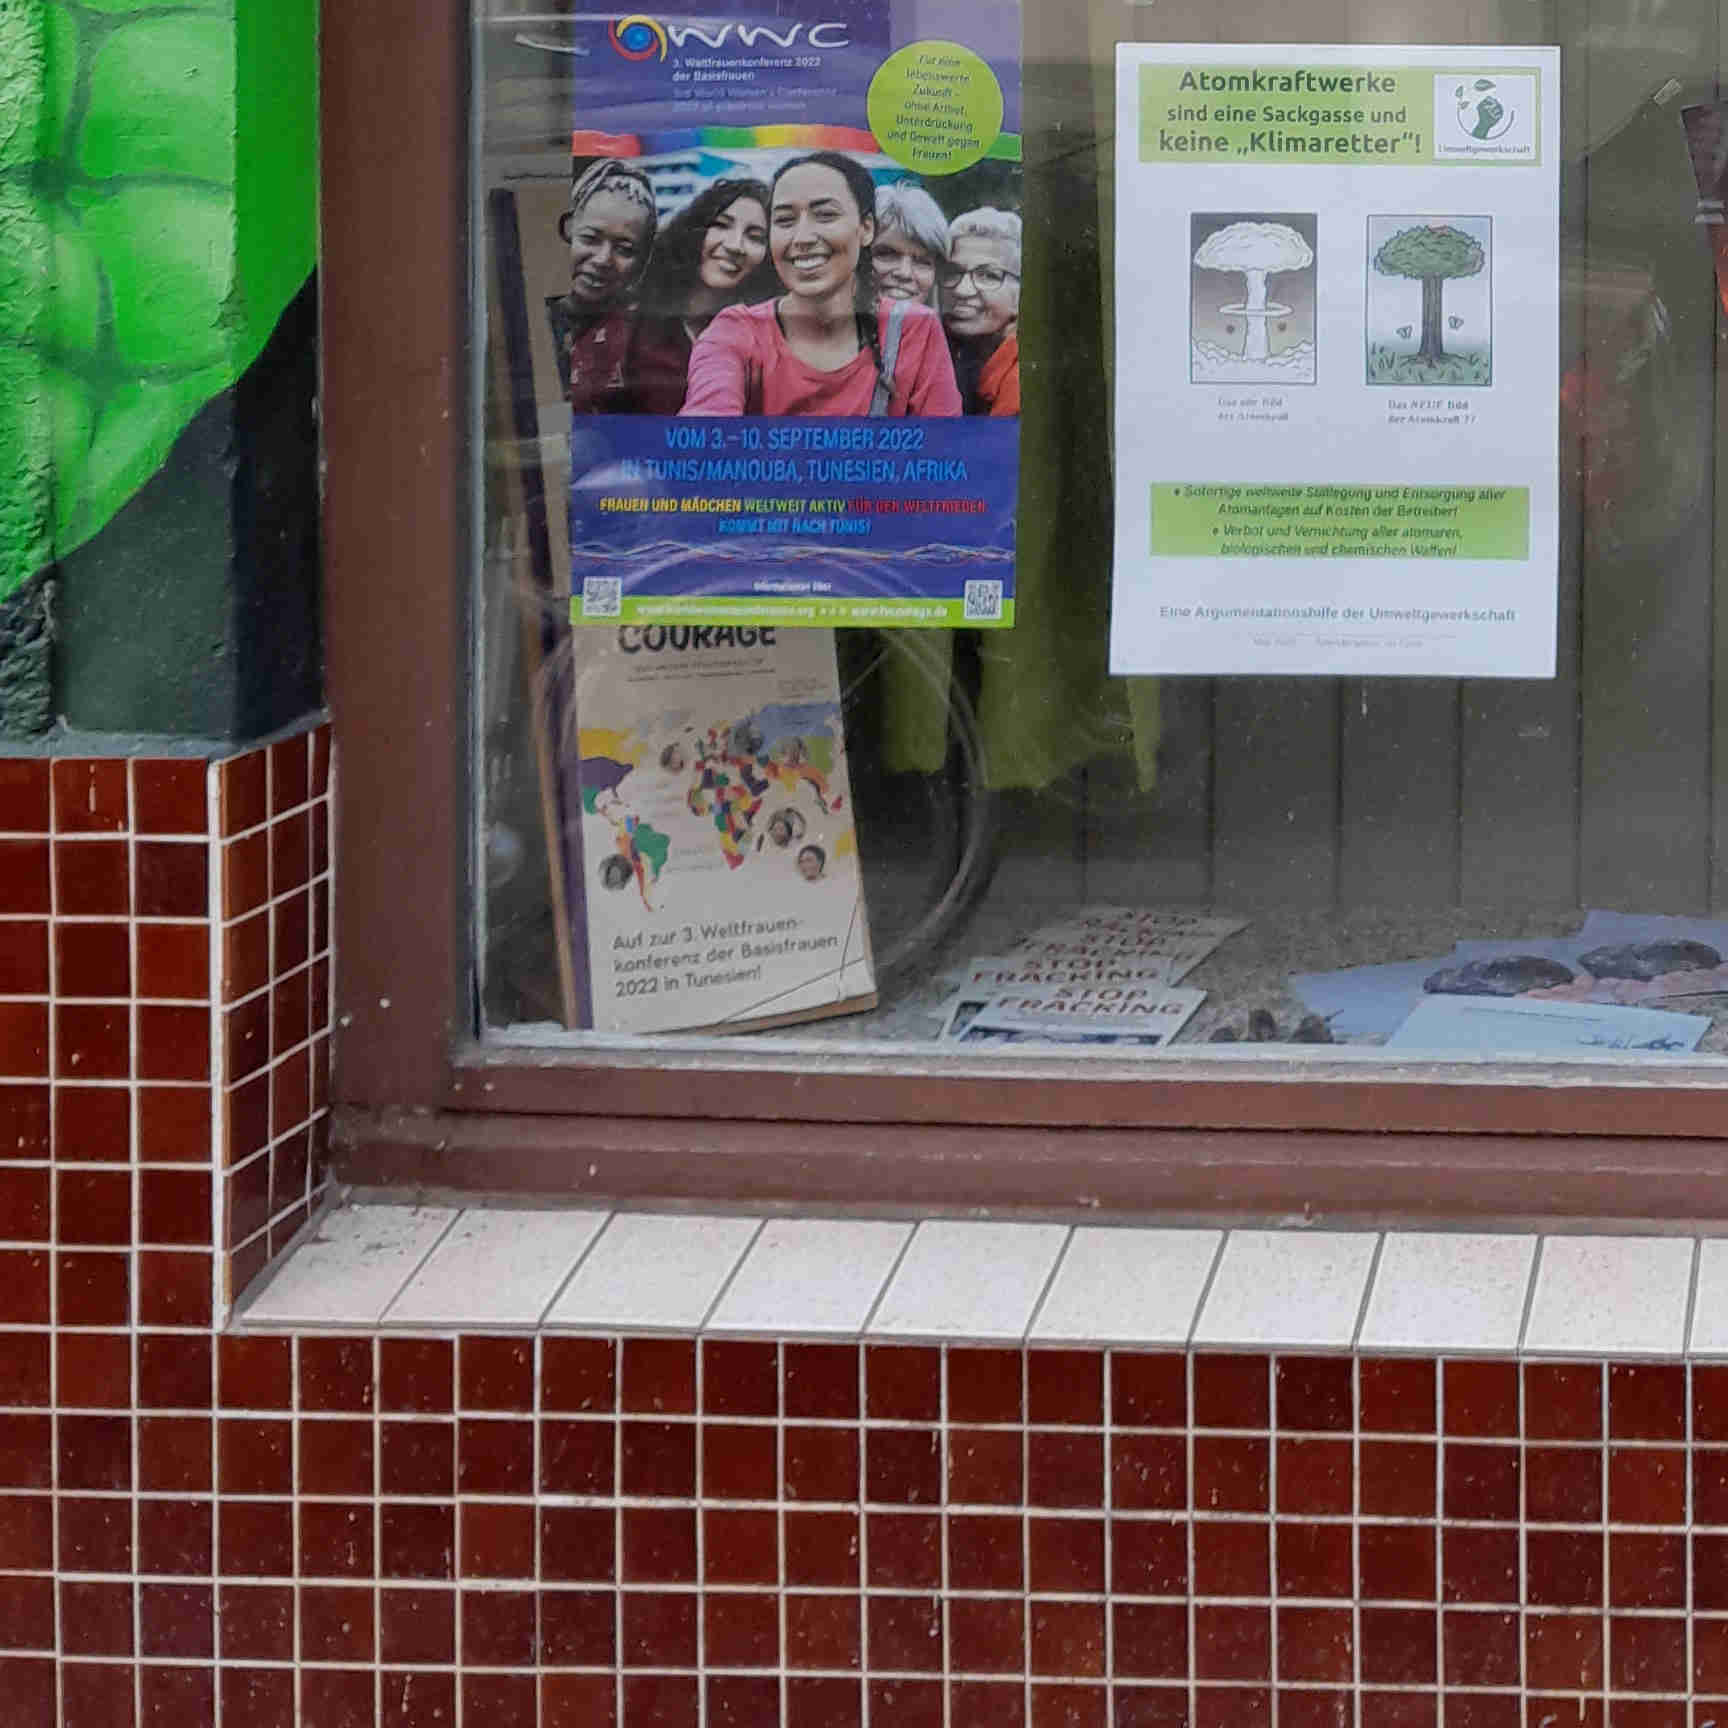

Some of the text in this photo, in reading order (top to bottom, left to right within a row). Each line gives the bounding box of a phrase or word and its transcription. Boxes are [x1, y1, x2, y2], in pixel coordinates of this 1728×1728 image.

[1178, 69, 1397, 94] Atomkraftwerke
[1167, 105, 1407, 127] sind eine Sackgasse und
[1158, 129, 1230, 152] keine
[1236, 131, 1423, 157] „Klimaretter“!
[665, 428, 706, 450] VOM
[767, 428, 875, 451] SEPTEMBER
[878, 427, 925, 450] 2022
[617, 624, 777, 654] COURAGE
